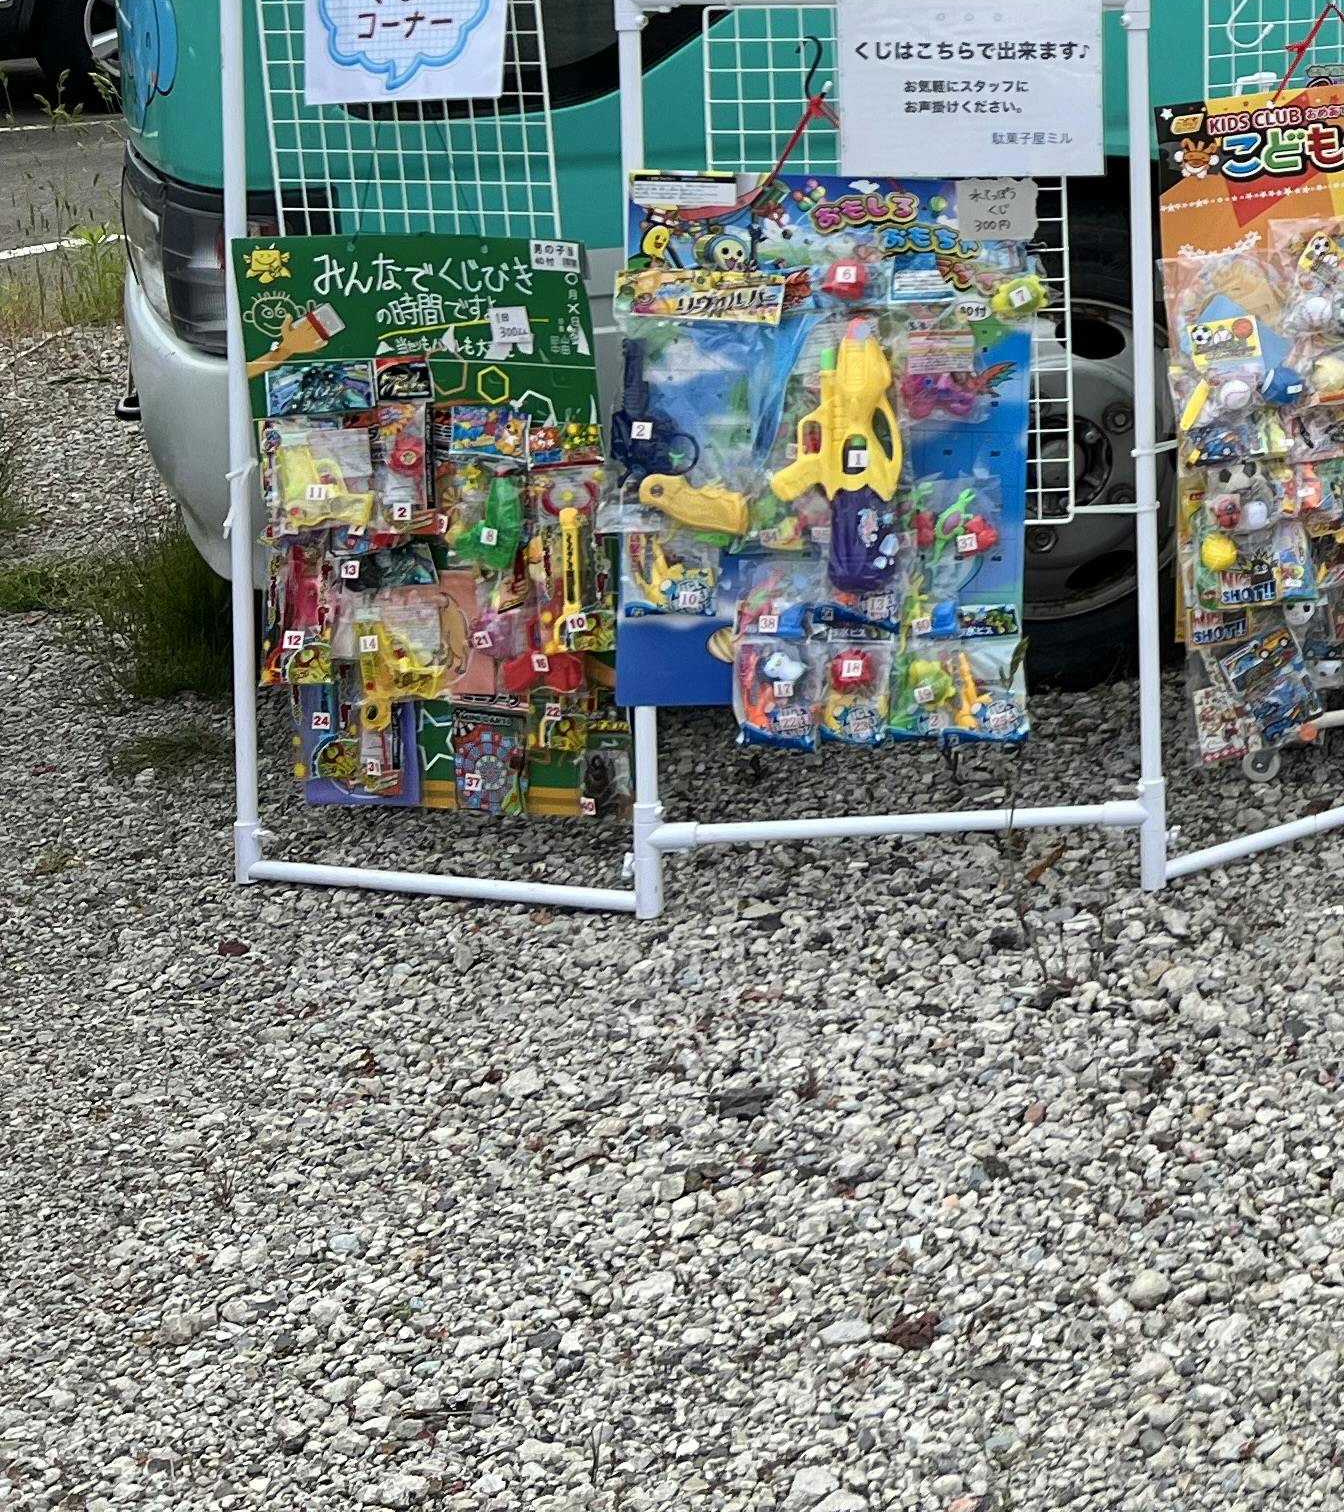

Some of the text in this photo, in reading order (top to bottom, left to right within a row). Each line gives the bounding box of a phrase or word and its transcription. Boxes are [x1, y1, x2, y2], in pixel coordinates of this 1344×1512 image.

[356, 9, 453, 42] コーナー
[903, 80, 1029, 93] お気軽にスタッフに
[1207, 112, 1249, 135] KIDS
[1253, 106, 1301, 128] CLUB
[991, 132, 1073, 145] 駄菓子屋ミル
[969, 187, 1017, 202] 水てっぽう
[814, 195, 915, 230] おもしろ
[988, 203, 1010, 216] くじ
[974, 219, 1012, 232] 300円
[882, 225, 980, 254] おもちゃ
[313, 252, 533, 296] みんなでくじびき
[842, 268, 851, 279] 6
[1015, 289, 1026, 303] 7
[636, 423, 645, 437] 2
[854, 453, 863, 466] 1
[309, 486, 324, 499] 11
[397, 507, 407, 518] 2
[958, 538, 975, 550] 37
[344, 565, 357, 575] 13
[682, 593, 698, 606] 10
[569, 618, 585, 629] 10
[761, 618, 775, 630] 38
[286, 635, 302, 646] 12
[362, 639, 376, 649] 14
[475, 634, 489, 646] 21
[844, 662, 861, 675] 18
[777, 683, 790, 695] 17
[313, 716, 328, 726] 24
[465, 777, 481, 787] 37
